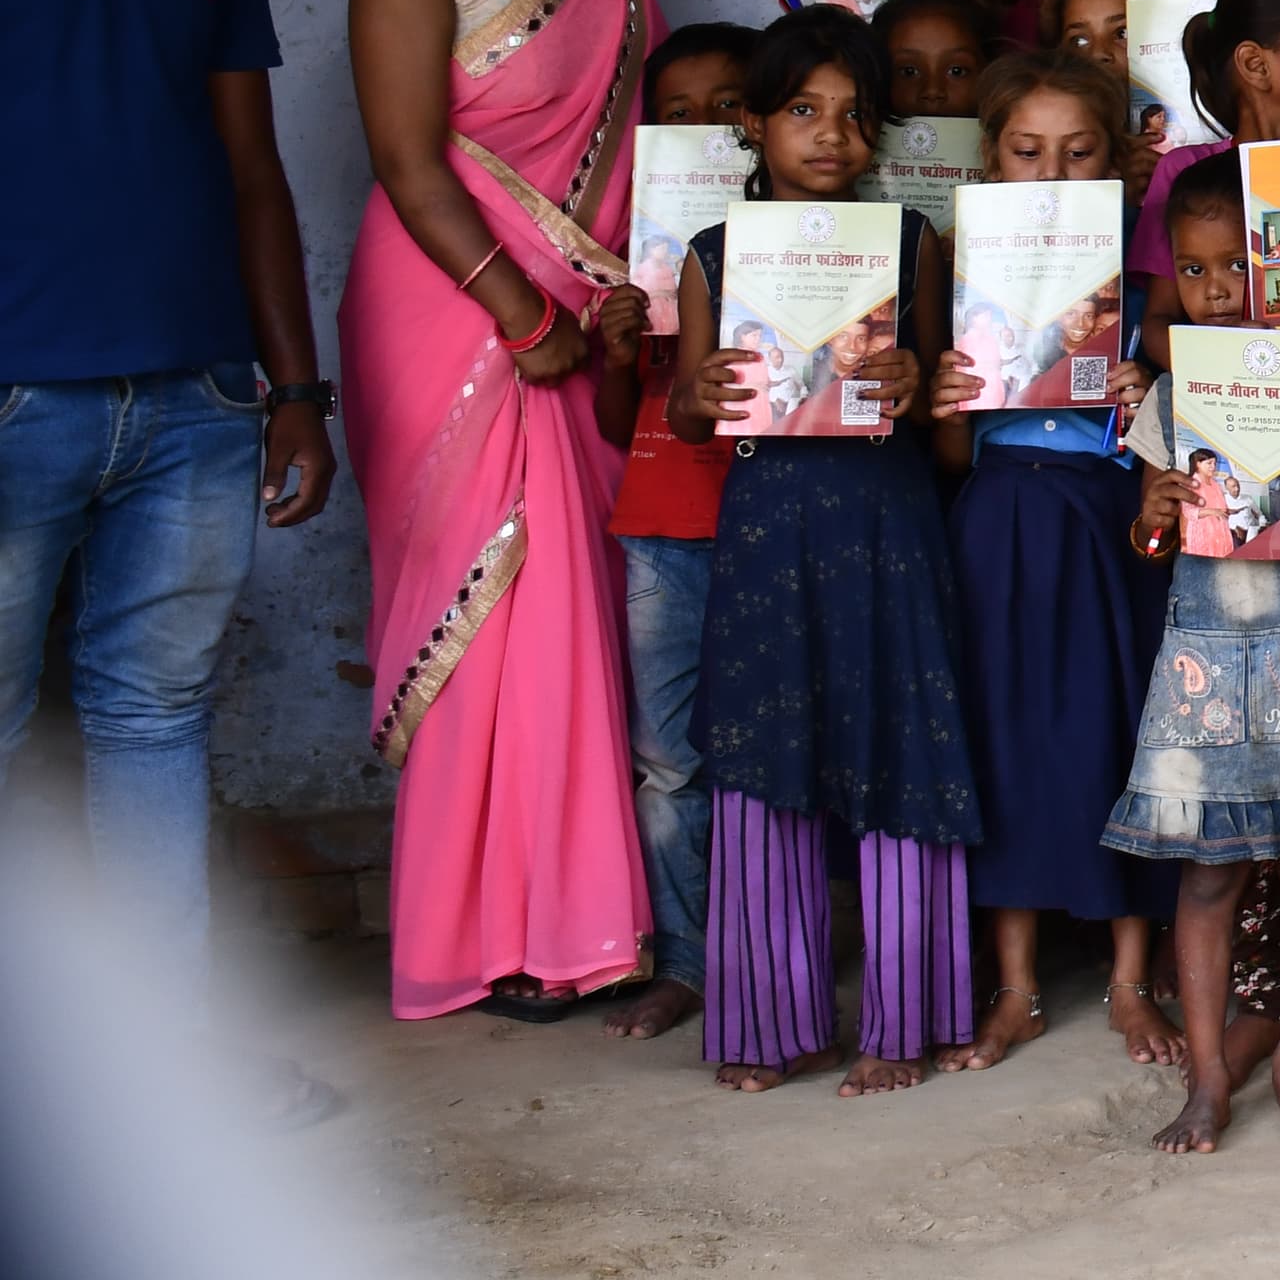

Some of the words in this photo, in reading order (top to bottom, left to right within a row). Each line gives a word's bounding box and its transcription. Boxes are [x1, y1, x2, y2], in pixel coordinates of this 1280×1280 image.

[684, 170, 715, 186] जीवन
[918, 163, 963, 180] फाउंडेशन
[738, 252, 776, 266] आनन्द
[778, 250, 812, 266] जीवन
[815, 250, 865, 267] फाउंडेशन
[868, 254, 890, 270] ट्रस्ट
[1186, 382, 1223, 397] आनन्द
[1226, 381, 1261, 399] जीवन
